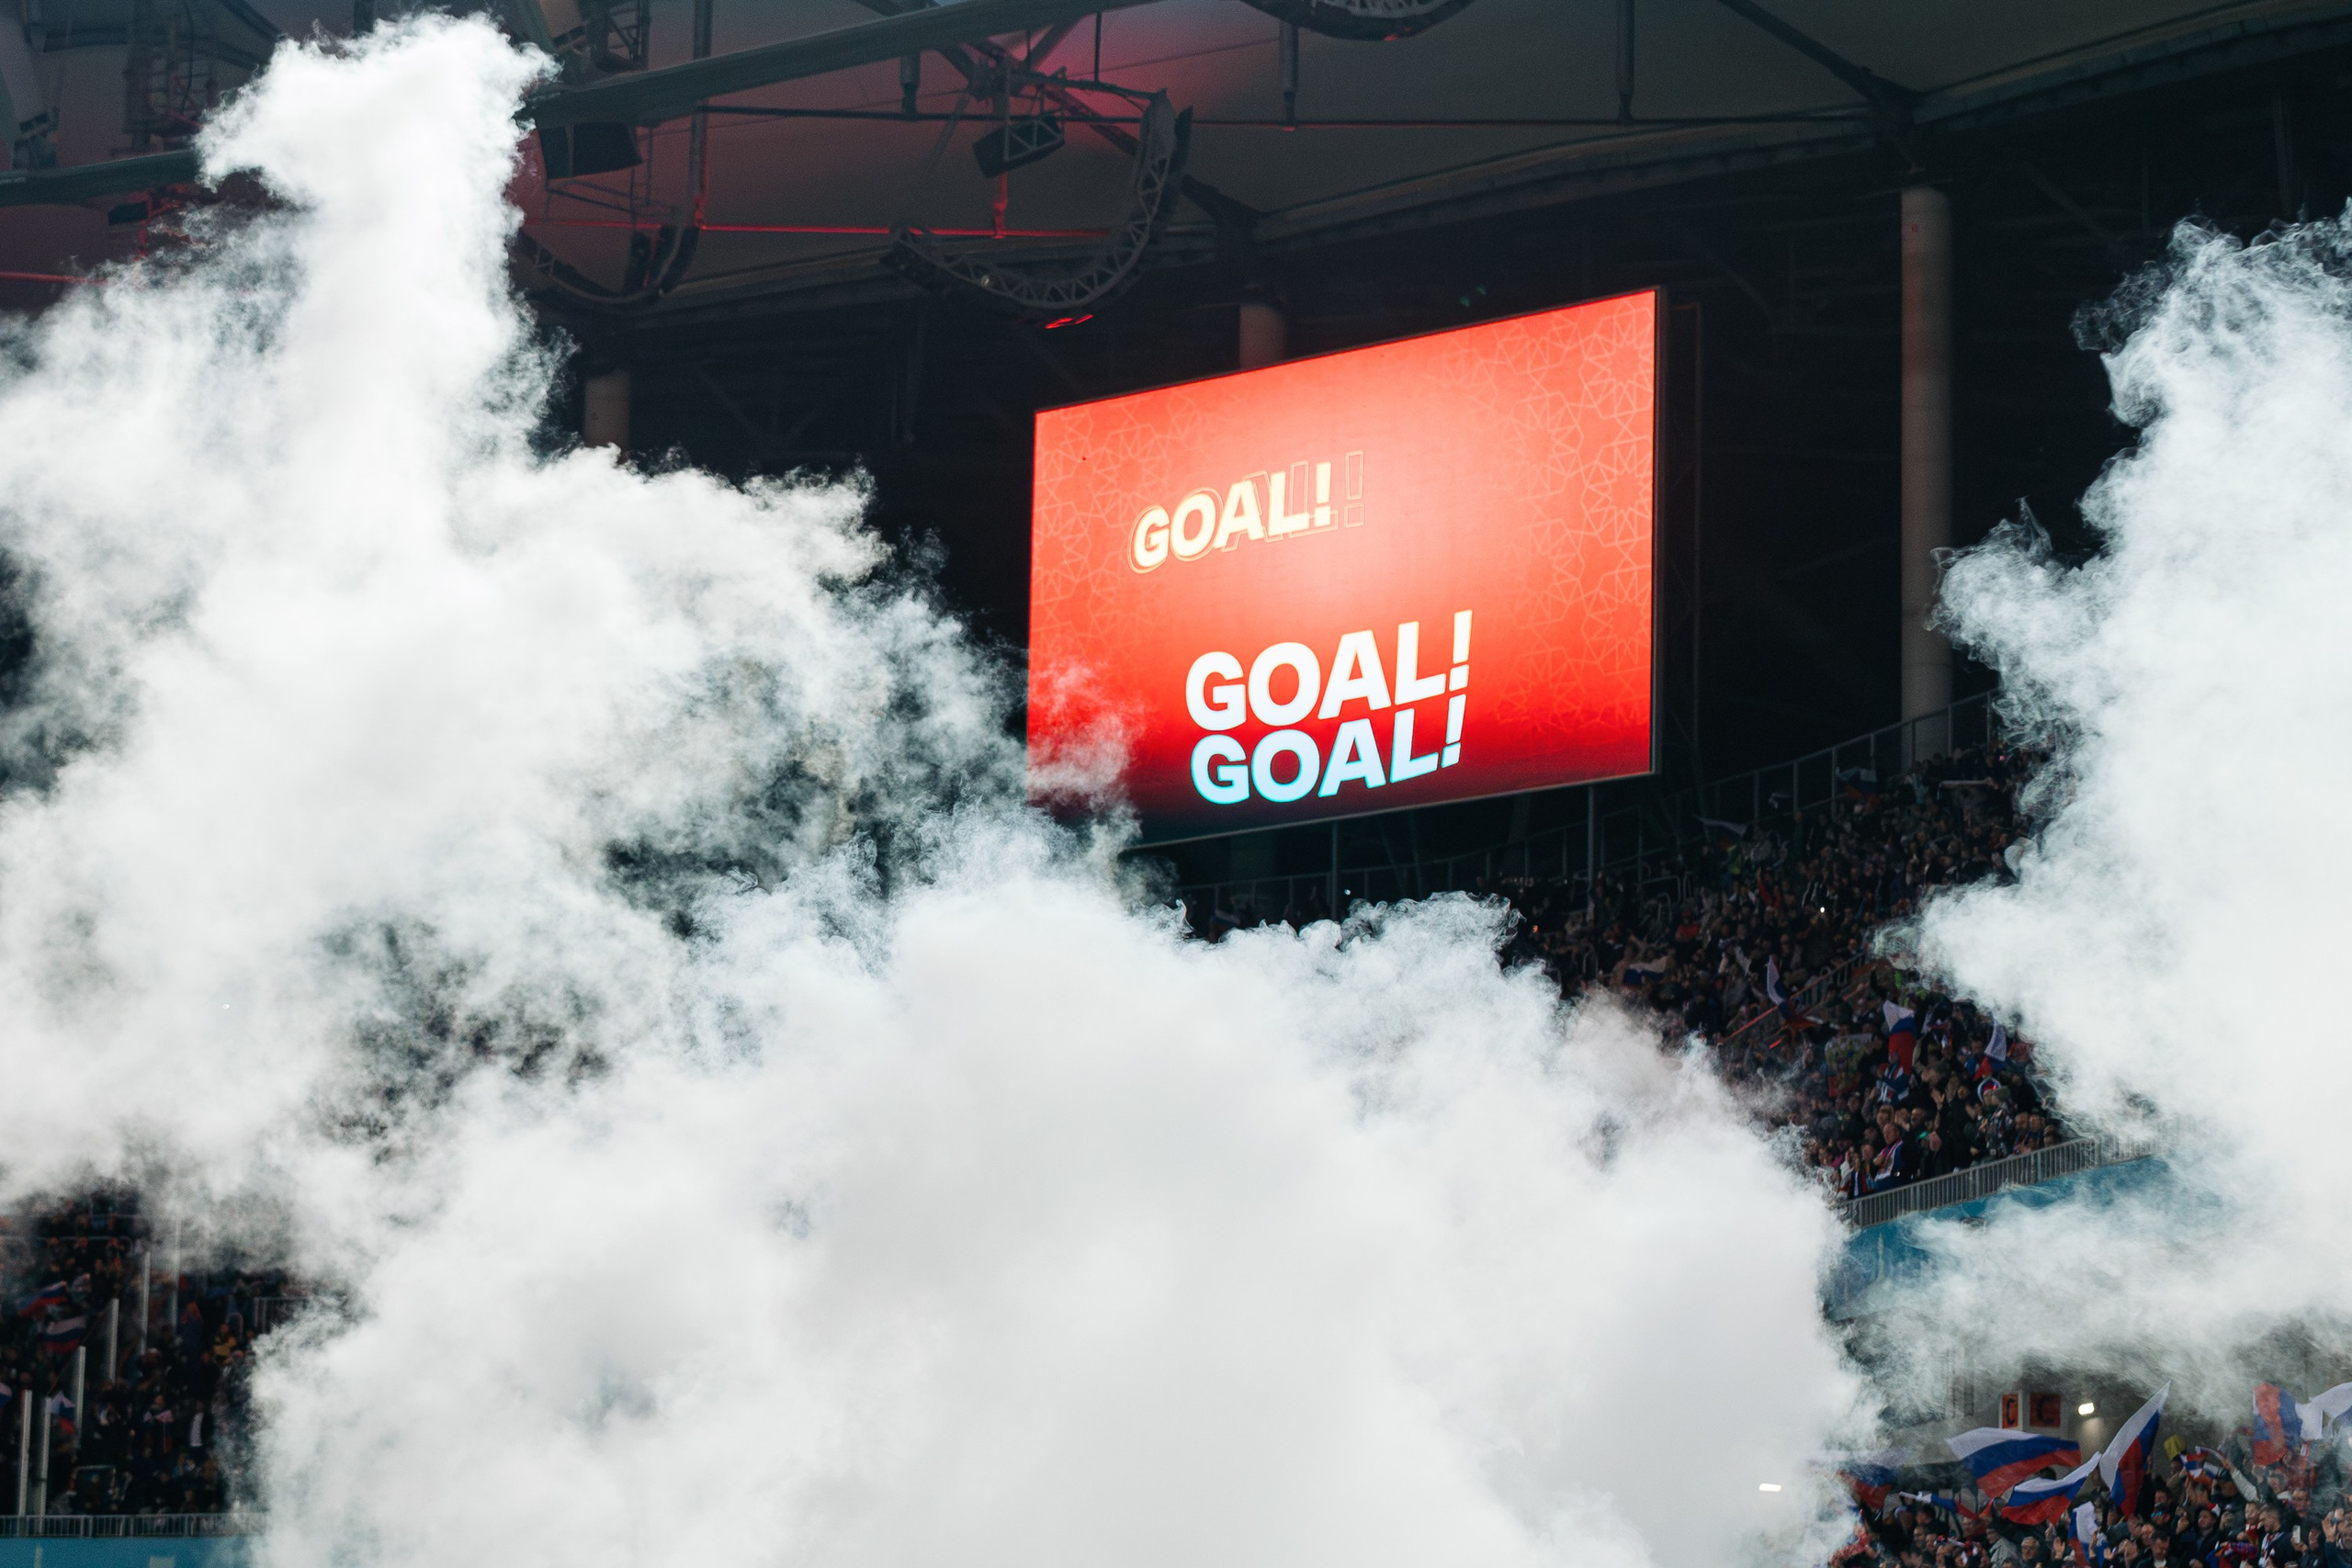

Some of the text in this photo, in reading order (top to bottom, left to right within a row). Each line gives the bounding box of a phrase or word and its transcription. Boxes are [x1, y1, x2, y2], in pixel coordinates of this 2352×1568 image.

[1133, 462, 1331, 568] GOAL!
[1185, 609, 1473, 731] GOAL!
[1191, 694, 1466, 805] GOAL!
